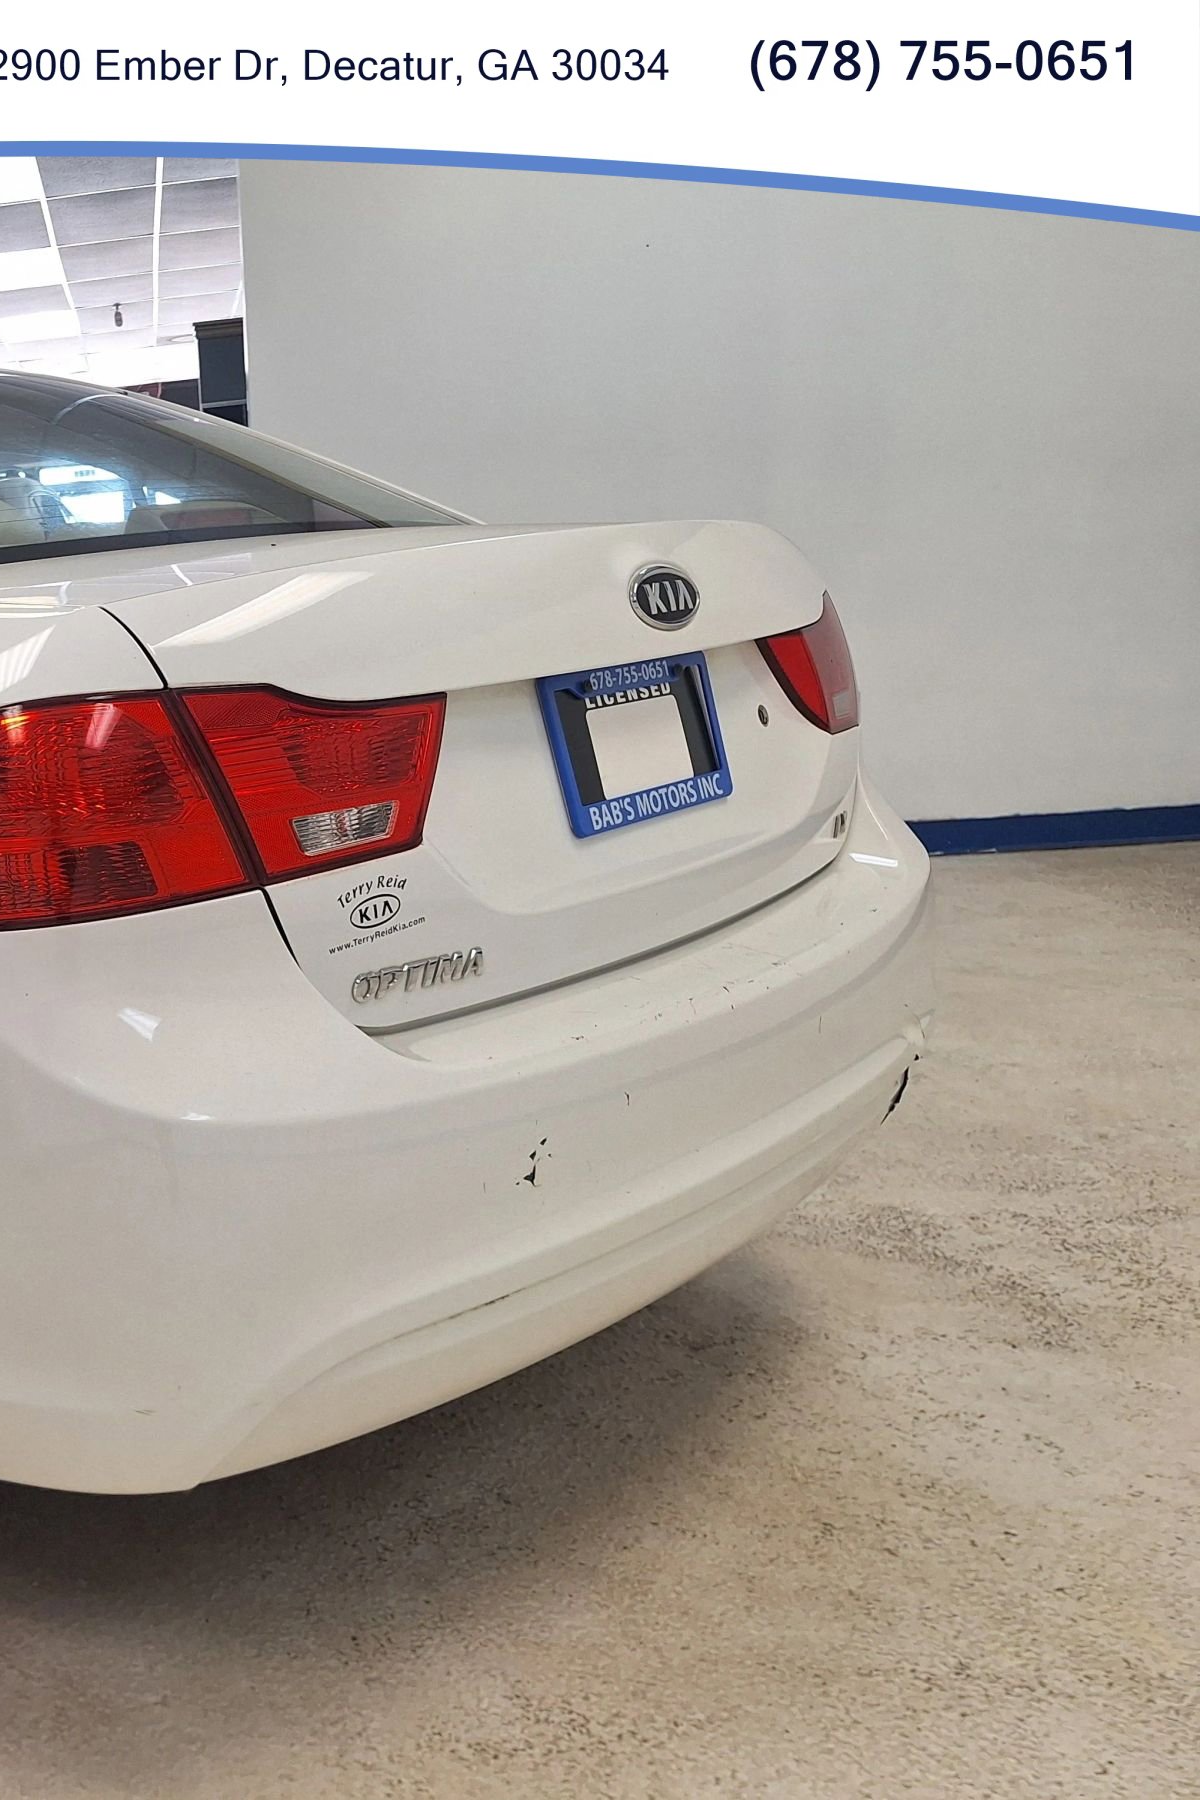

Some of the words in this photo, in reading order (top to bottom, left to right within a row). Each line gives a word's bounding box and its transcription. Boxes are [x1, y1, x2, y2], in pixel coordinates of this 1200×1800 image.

[641, 579, 694, 615] KIA
[589, 660, 670, 690] 678-755-0651
[589, 797, 635, 831] BAB'S
[636, 780, 698, 818] MOTORS
[699, 773, 724, 796] INC
[337, 880, 373, 909] Terry
[376, 875, 408, 890] Reid
[358, 900, 394, 924] KIA
[329, 916, 426, 955] www.TerryReidKia.com
[352, 946, 483, 1004] OPTIMA
